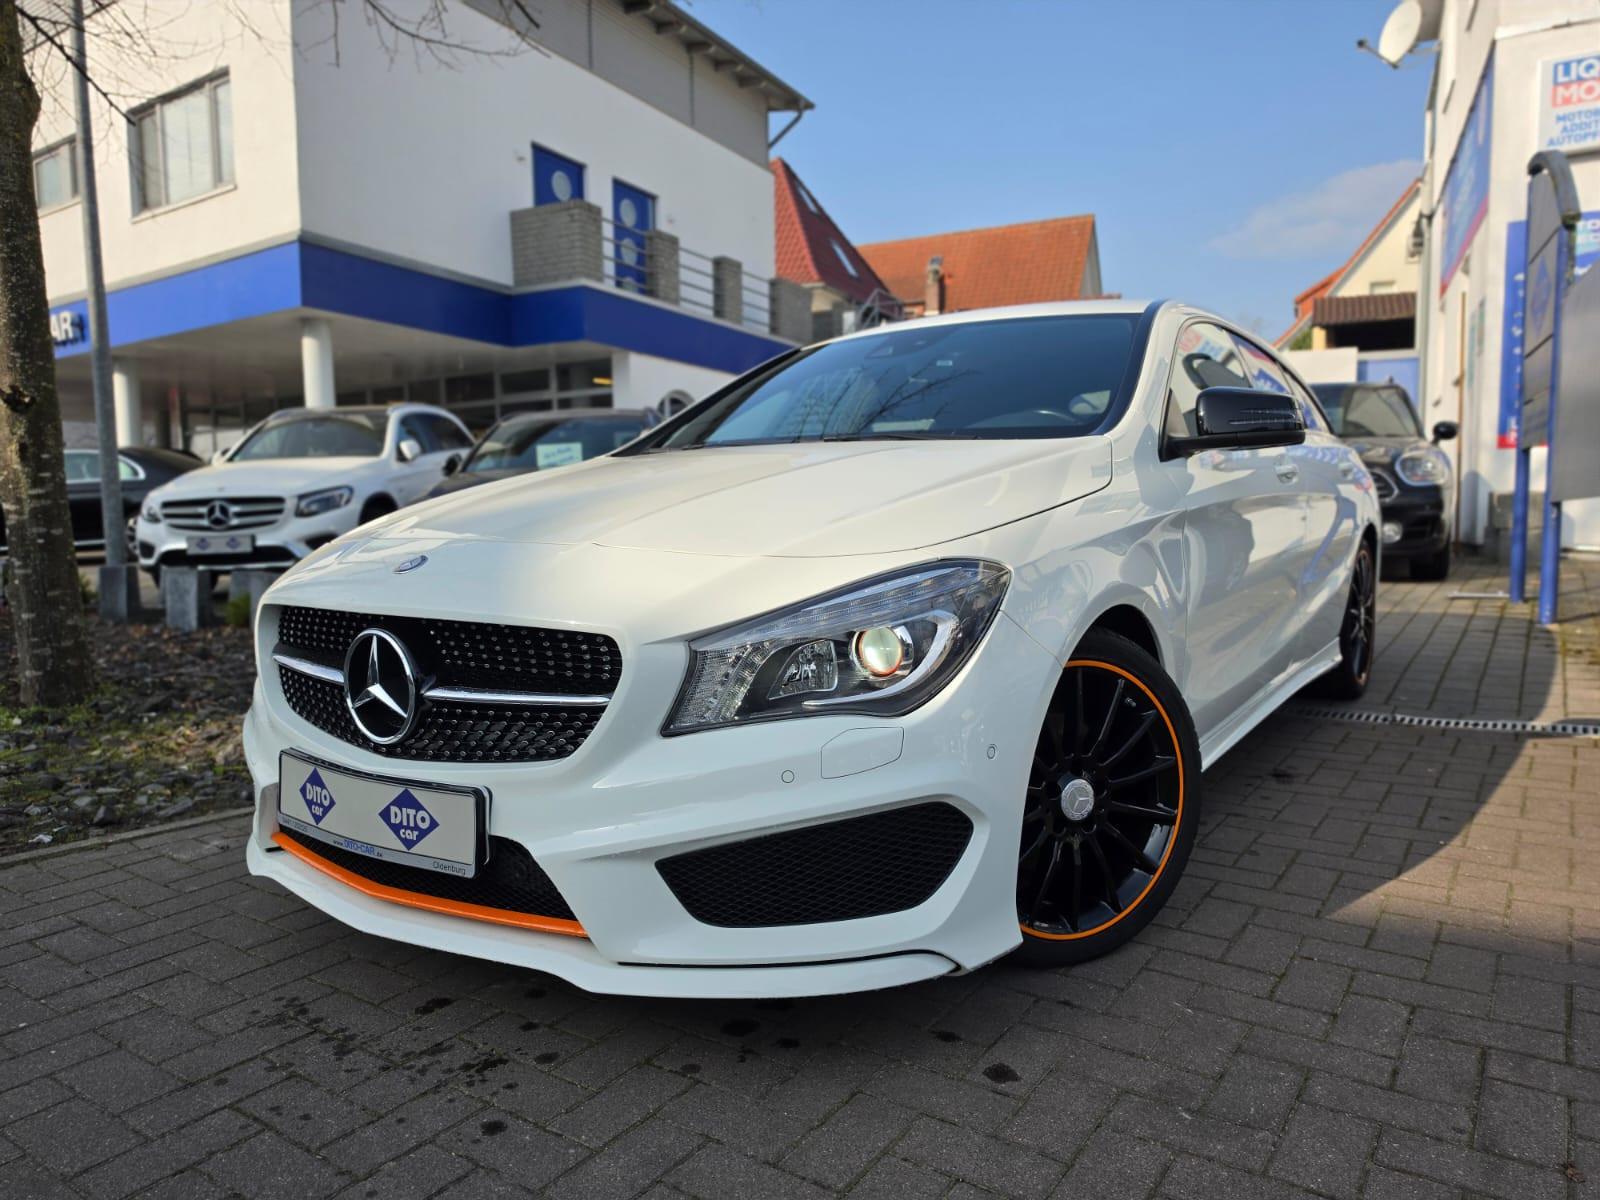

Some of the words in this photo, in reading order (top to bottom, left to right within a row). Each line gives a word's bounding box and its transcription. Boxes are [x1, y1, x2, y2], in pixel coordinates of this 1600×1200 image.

[306, 782, 331, 807] DITO
[311, 804, 324, 817] car
[389, 805, 431, 830] DITO
[400, 828, 420, 841] car
[432, 861, 466, 876] Oldenburg
